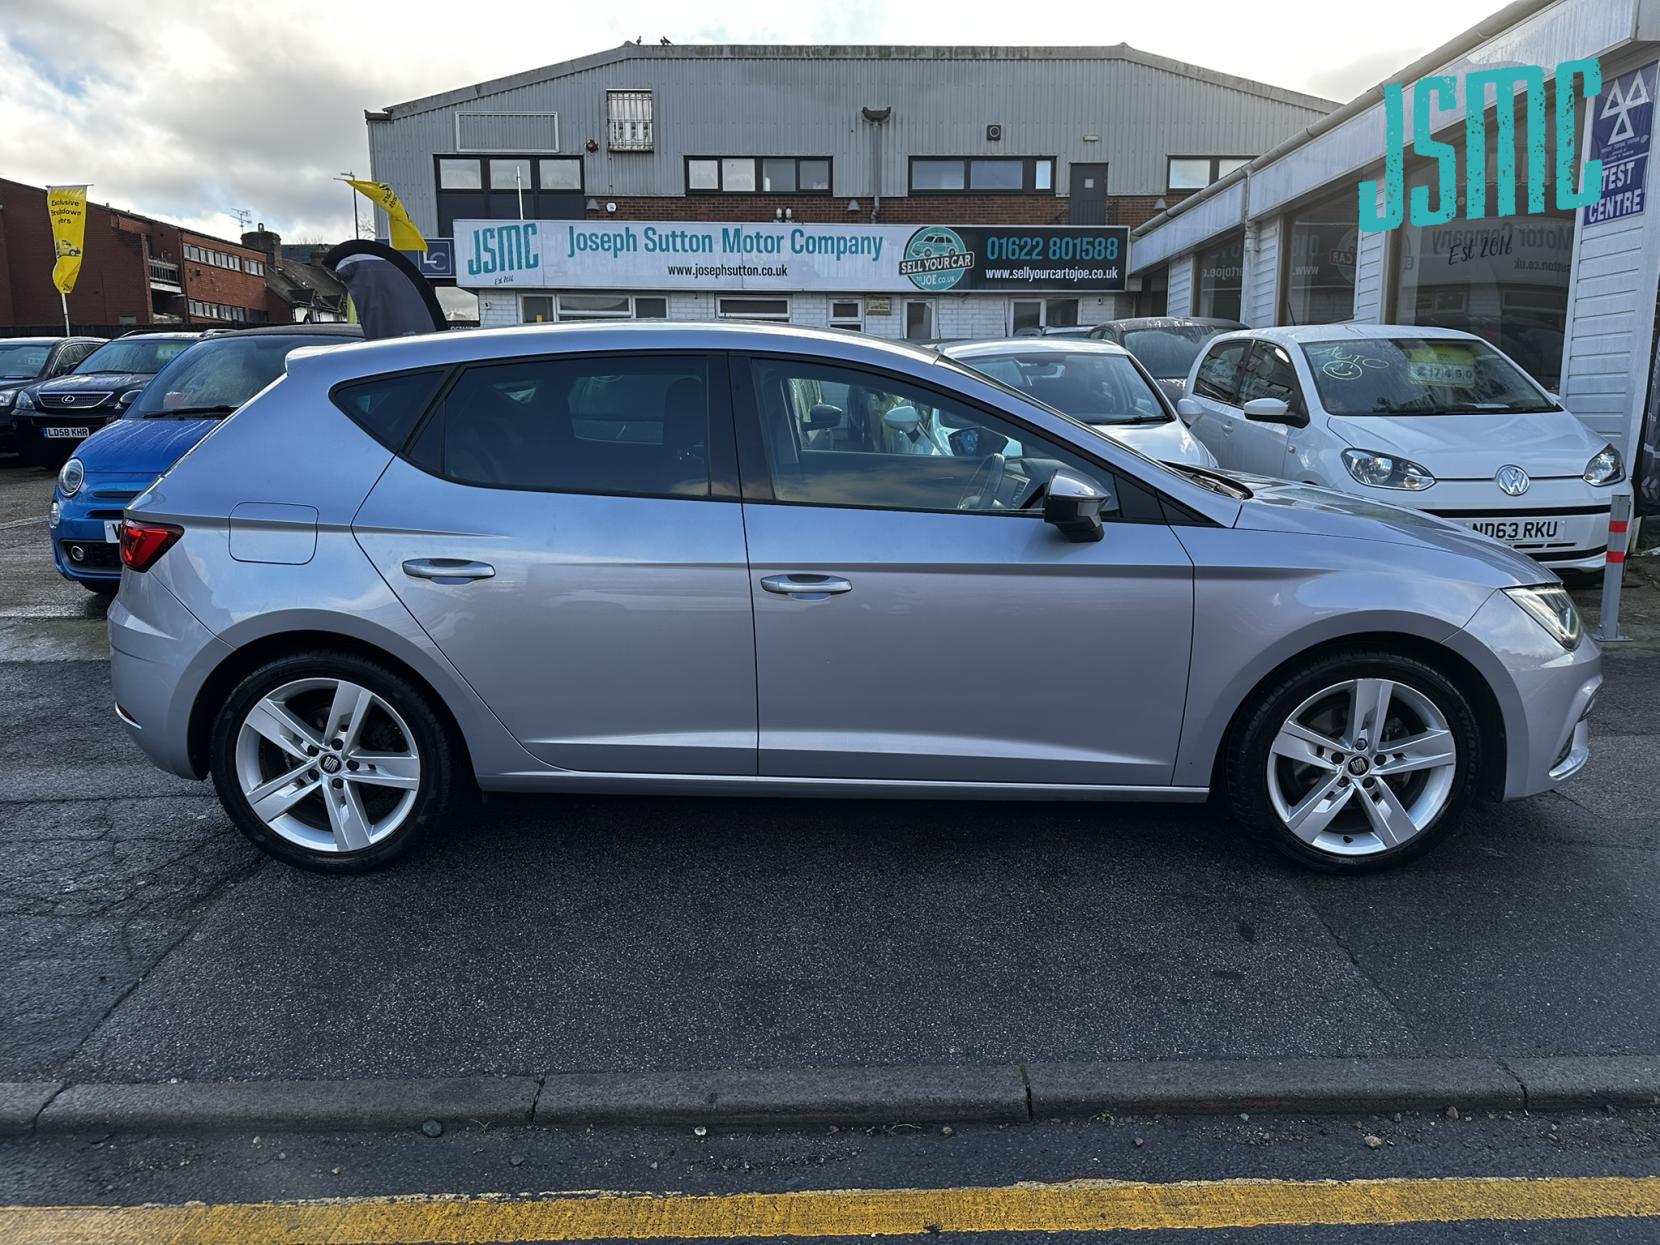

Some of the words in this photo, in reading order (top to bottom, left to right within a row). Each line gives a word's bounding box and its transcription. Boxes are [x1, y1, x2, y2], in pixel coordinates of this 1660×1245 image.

[1601, 161, 1635, 191] TEST
[1588, 187, 1642, 223] CENTRE
[467, 223, 539, 276] JSMC
[568, 226, 638, 259] Joseph
[644, 227, 713, 253] Sutton
[721, 228, 785, 254] Motor
[790, 229, 883, 262] Company
[987, 237, 1044, 260] 01622
[1048, 237, 1119, 260] 801588
[667, 263, 788, 279] www.josephsutton.co.uk
[901, 260, 923, 274] SELL
[924, 257, 950, 271] YOUR
[950, 254, 972, 268] CAR
[985, 266, 1119, 282] www.sellyourcartojoe.co.uk
[921, 274, 937, 286] JOE
[71, 428, 88, 437] KHR
[1522, 521, 1558, 538] RKU
